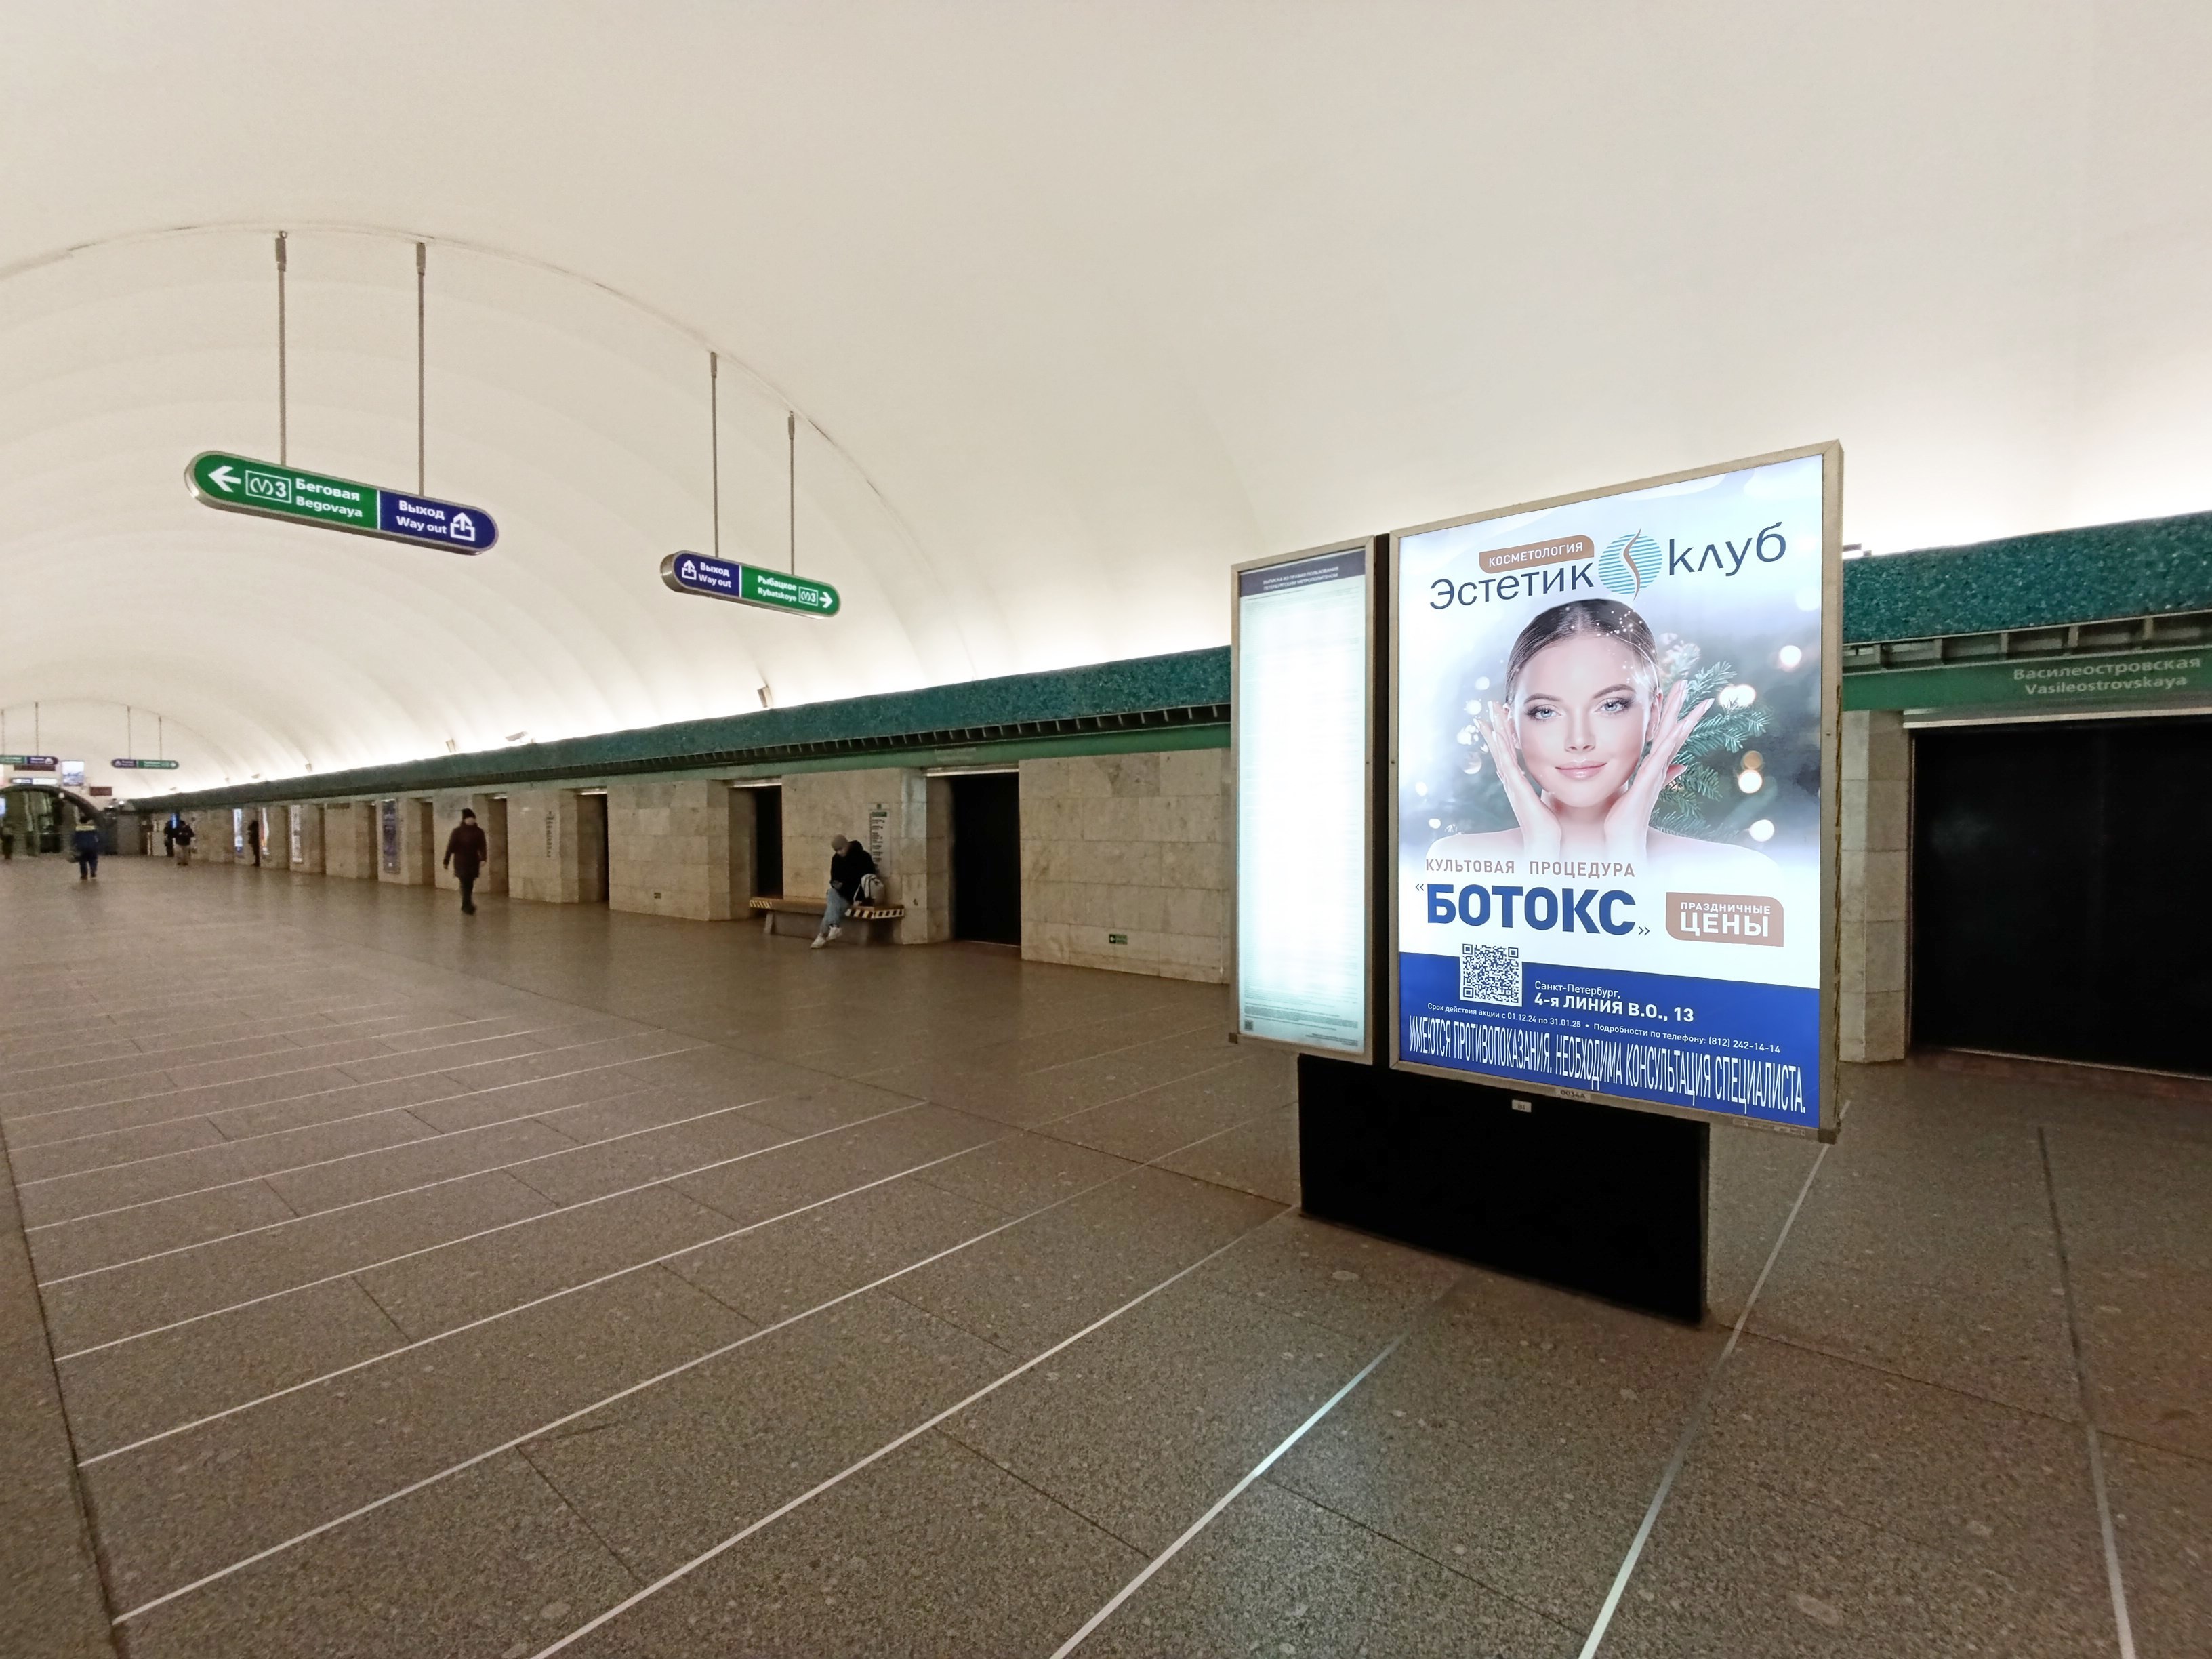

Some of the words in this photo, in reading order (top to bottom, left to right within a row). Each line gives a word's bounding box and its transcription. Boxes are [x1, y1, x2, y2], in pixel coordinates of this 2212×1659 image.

[295, 478, 360, 501] Беговая
[296, 495, 363, 518] Begovaya
[398, 499, 445, 520] Выход
[396, 516, 424, 532] Way
[426, 522, 447, 535] out
[1488, 541, 1583, 567] КОСМЕТОЛОГИЯ
[700, 562, 730, 577] Выход
[1429, 562, 1595, 609] Эстетик
[1668, 521, 1786, 577] клуб
[698, 573, 717, 586] Way
[718, 579, 732, 588] out
[758, 575, 797, 591] Рыбацкое
[758, 587, 797, 602] Rybatskoye
[2013, 657, 2201, 680] Василеостровская
[2025, 676, 2188, 695] Vasileostrovskaya
[1426, 859, 1515, 874] КУЛЬТОВАЯ
[1530, 861, 1635, 879] ПРОЦЕДУРА
[1681, 901, 1771, 914] ПРАЗДНИЧНЫЕ
[1681, 912, 1768, 937] ЦЕНЫ
[1534, 981, 1620, 1000] Санкт-Петербург,
[1534, 992, 1559, 1008] 4-я
[1563, 995, 1623, 1015] ЛИНИЯ
[1628, 1002, 1668, 1022] В.О.,
[1674, 1006, 1694, 1022] 13
[1427, 1002, 1445, 1014] Срок
[1445, 1004, 1477, 1015] действия
[1478, 1010, 1500, 1019] акции
[1507, 1012, 1536, 1023] 01.12.24
[1549, 1017, 1581, 1028] 31.01.25
[1594, 1023, 1648, 1037] Подробности
[1662, 1031, 1706, 1044] телефону:
[1709, 1036, 1730, 1047] (812)
[1733, 1040, 1780, 1054] 242-14-14
[1409, 1015, 1451, 1058] ИМЕЮТСЯ
[1454, 1021, 1552, 1073] ПРОТИВОПОКАЗАНИЯ.
[1555, 1033, 1622, 1091] НЕОБХОДИМА
[1626, 1042, 1711, 1106] КОНСУЛЬТАЦИЯ
[1715, 1055, 1806, 1114] СПЕЦИАЛИСТА.
